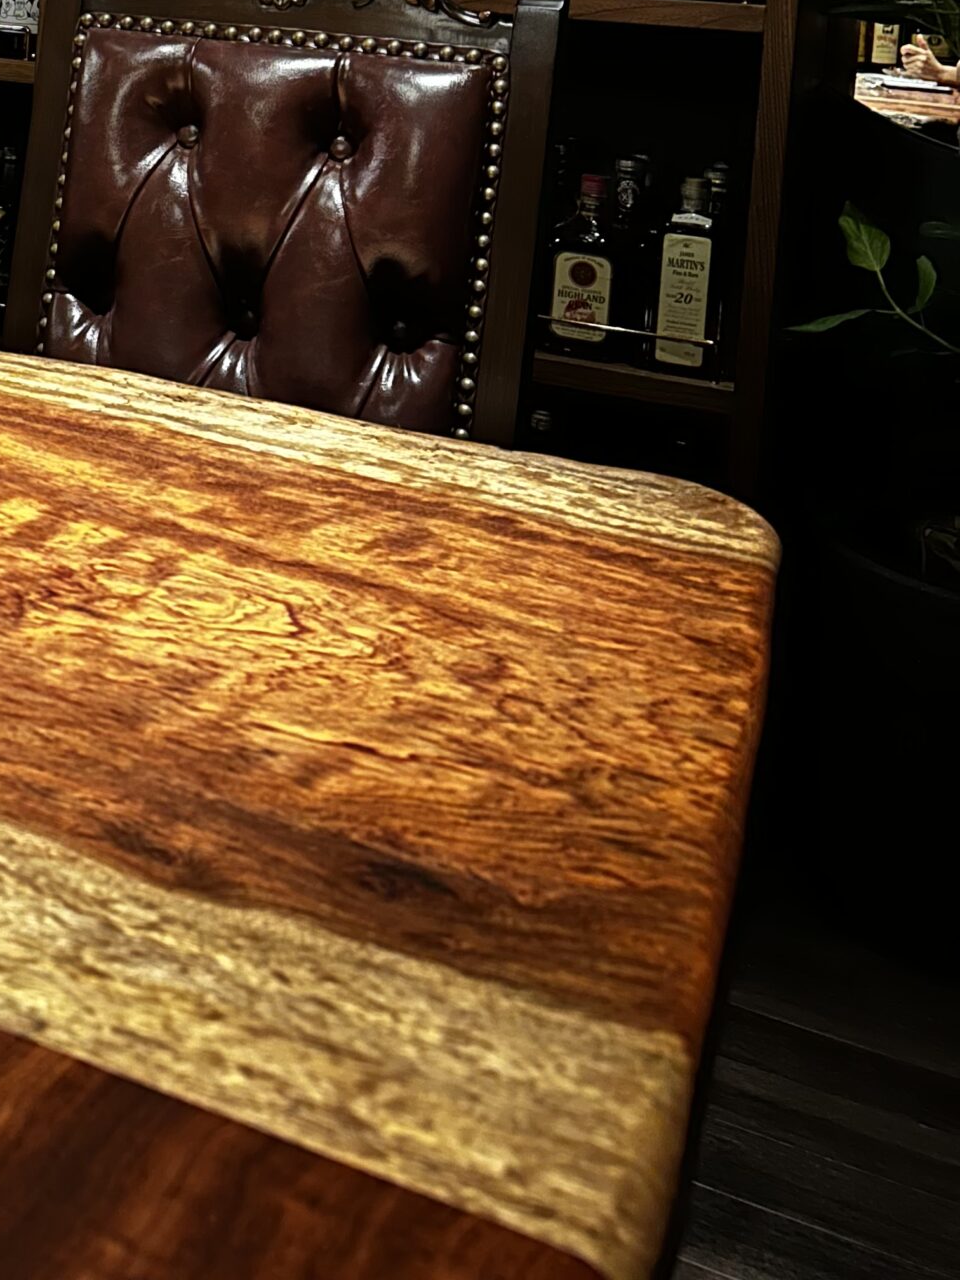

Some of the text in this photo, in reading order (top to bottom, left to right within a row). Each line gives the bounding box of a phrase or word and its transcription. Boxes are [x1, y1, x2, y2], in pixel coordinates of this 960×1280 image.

[667, 257, 706, 271] MARTIN'S
[557, 288, 606, 304] HIGHLAND
[673, 292, 694, 305] 20
